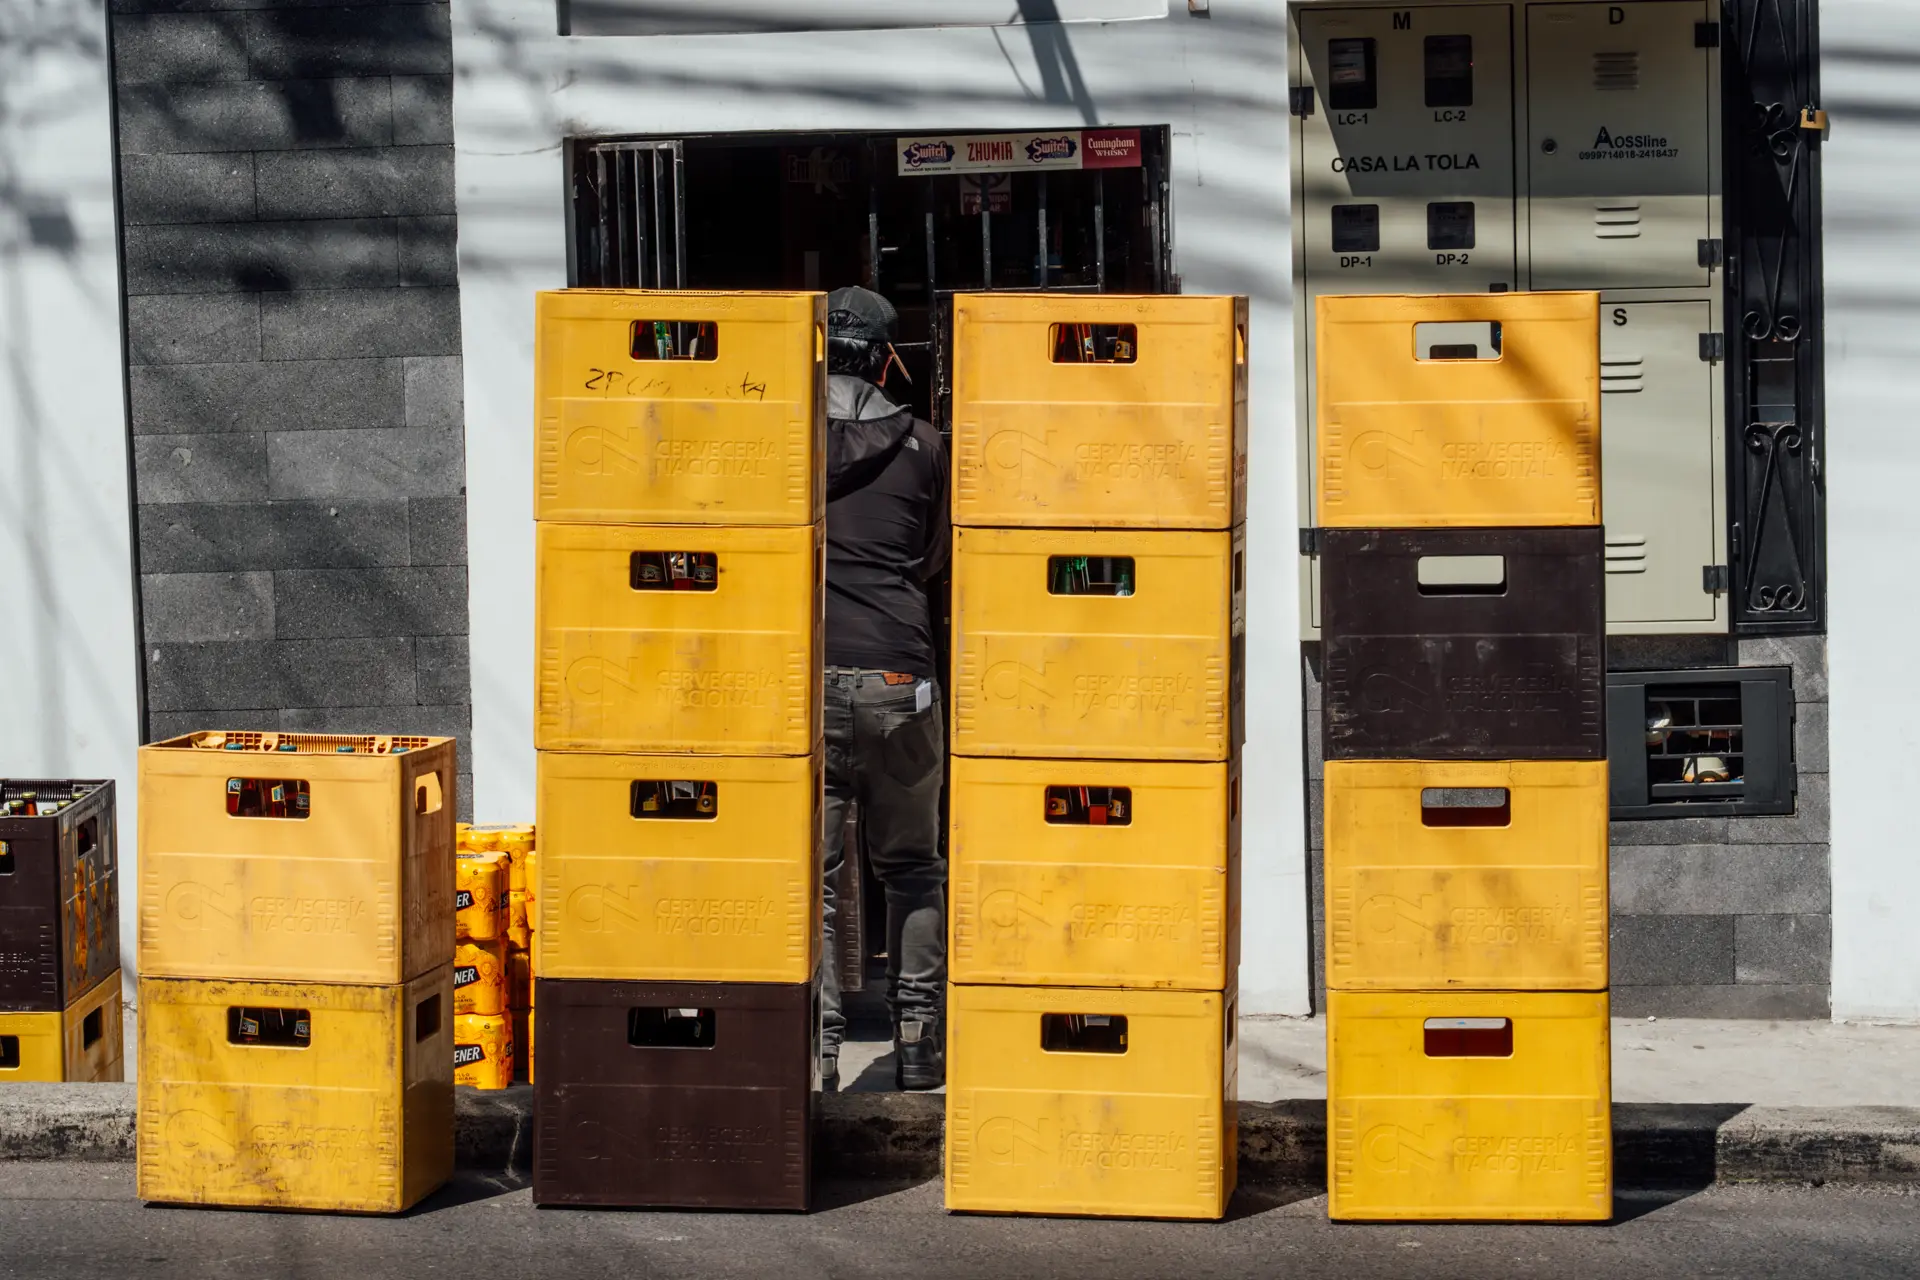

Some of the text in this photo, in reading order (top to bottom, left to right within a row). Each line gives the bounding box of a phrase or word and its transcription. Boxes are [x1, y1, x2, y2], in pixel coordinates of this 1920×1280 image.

[1393, 11, 1411, 30] M
[1609, 8, 1625, 25] D
[1337, 113, 1369, 126] LC-1
[1434, 110, 1467, 123] LC-2
[1032, 137, 1070, 162] Switch
[1088, 137, 1136, 151] Cuningham
[1095, 148, 1129, 157] WHISKY
[910, 141, 948, 168] Switch
[1331, 153, 1480, 174] CASA LA TOLA
[1340, 255, 1372, 268] DP-1
[1436, 253, 1469, 266] DP-2
[1613, 308, 1628, 326] S
[654, 459, 767, 478] NACIONAL
[1074, 462, 1187, 480] NACIONAL
[1441, 460, 1554, 480] NACIONAL
[654, 690, 766, 708] NACIONAL
[1072, 693, 1185, 712] NACIONAL
[456, 893, 469, 907] ER
[251, 916, 358, 934] NACIONAL
[655, 917, 765, 936] NACIONAL
[1069, 922, 1180, 941] NACIONAL
[1450, 925, 1564, 944] NACIONAL
[454, 969, 475, 984] NER
[454, 1046, 480, 1063] ENER
[1065, 1151, 1177, 1170] NACIONAL
[1452, 1154, 1566, 1173] NACIONAL
